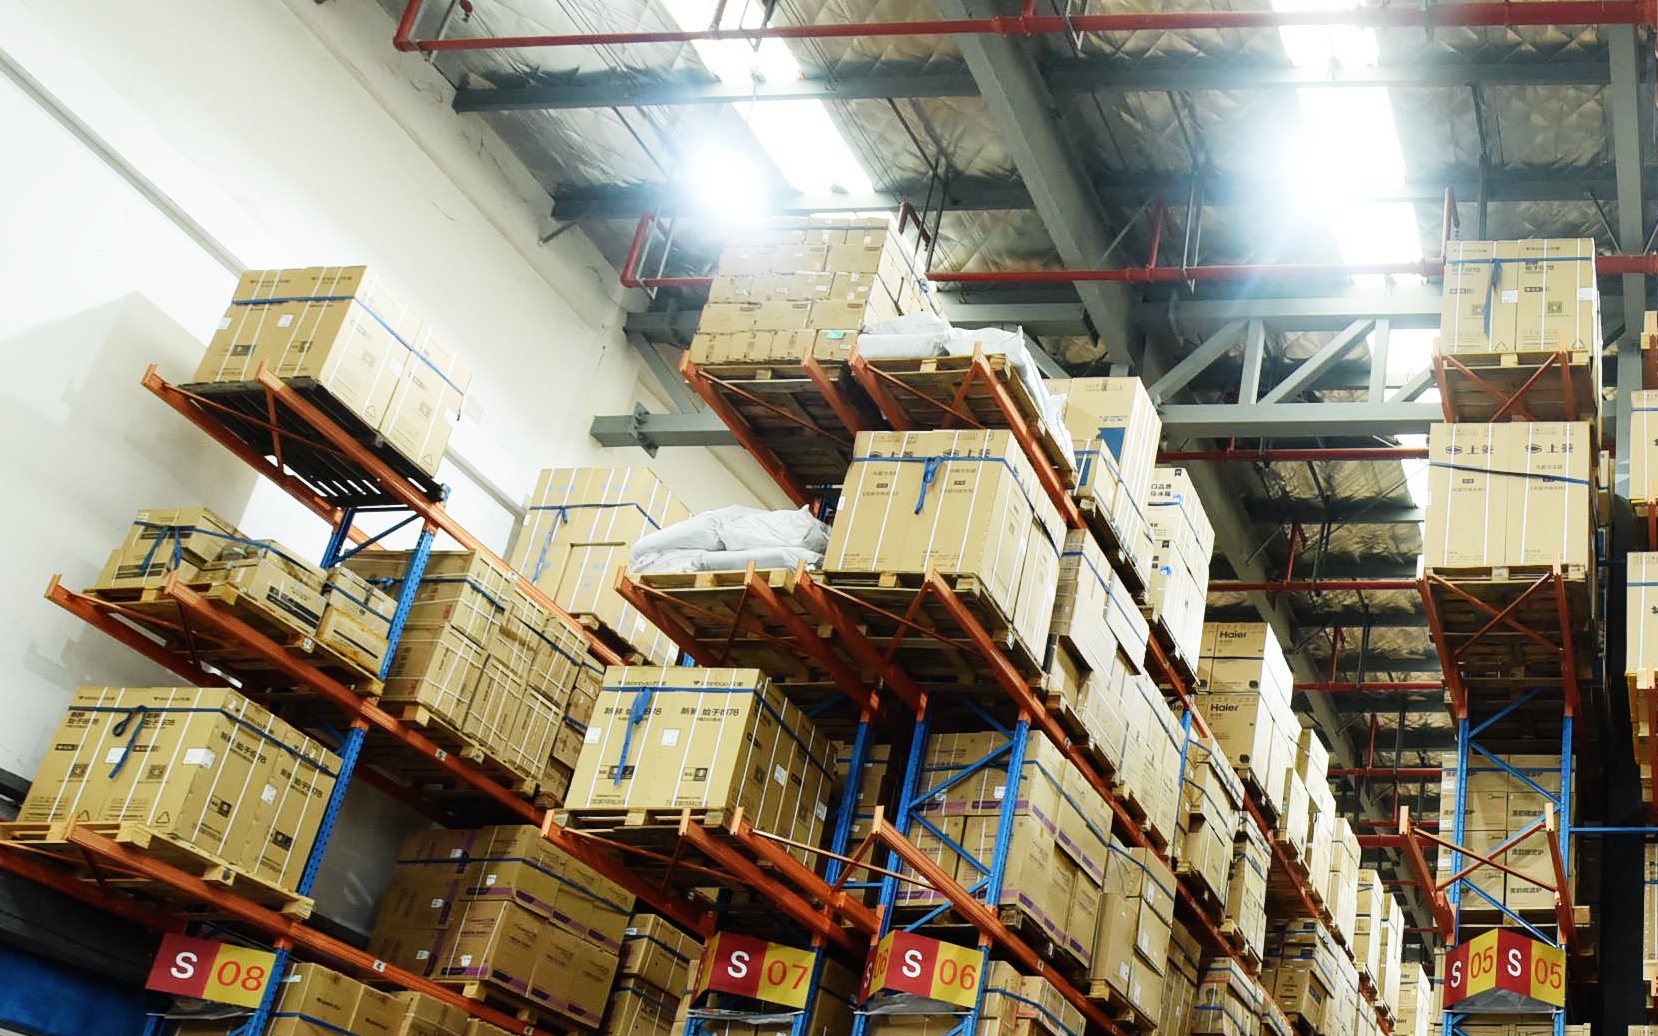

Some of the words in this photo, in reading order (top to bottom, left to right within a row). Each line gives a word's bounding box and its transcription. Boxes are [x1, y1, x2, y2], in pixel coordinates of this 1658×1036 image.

[1219, 630, 1247, 639] Haier
[1210, 704, 1238, 713] Haier
[170, 951, 198, 979] S
[217, 961, 265, 991] 08
[727, 950, 750, 978] S
[767, 959, 808, 990] 07
[902, 950, 923, 978] S
[939, 959, 977, 990] 06
[1451, 960, 1462, 988] S
[1470, 944, 1494, 979] 05
[1506, 948, 1522, 977] S
[1534, 958, 1562, 989] 05
